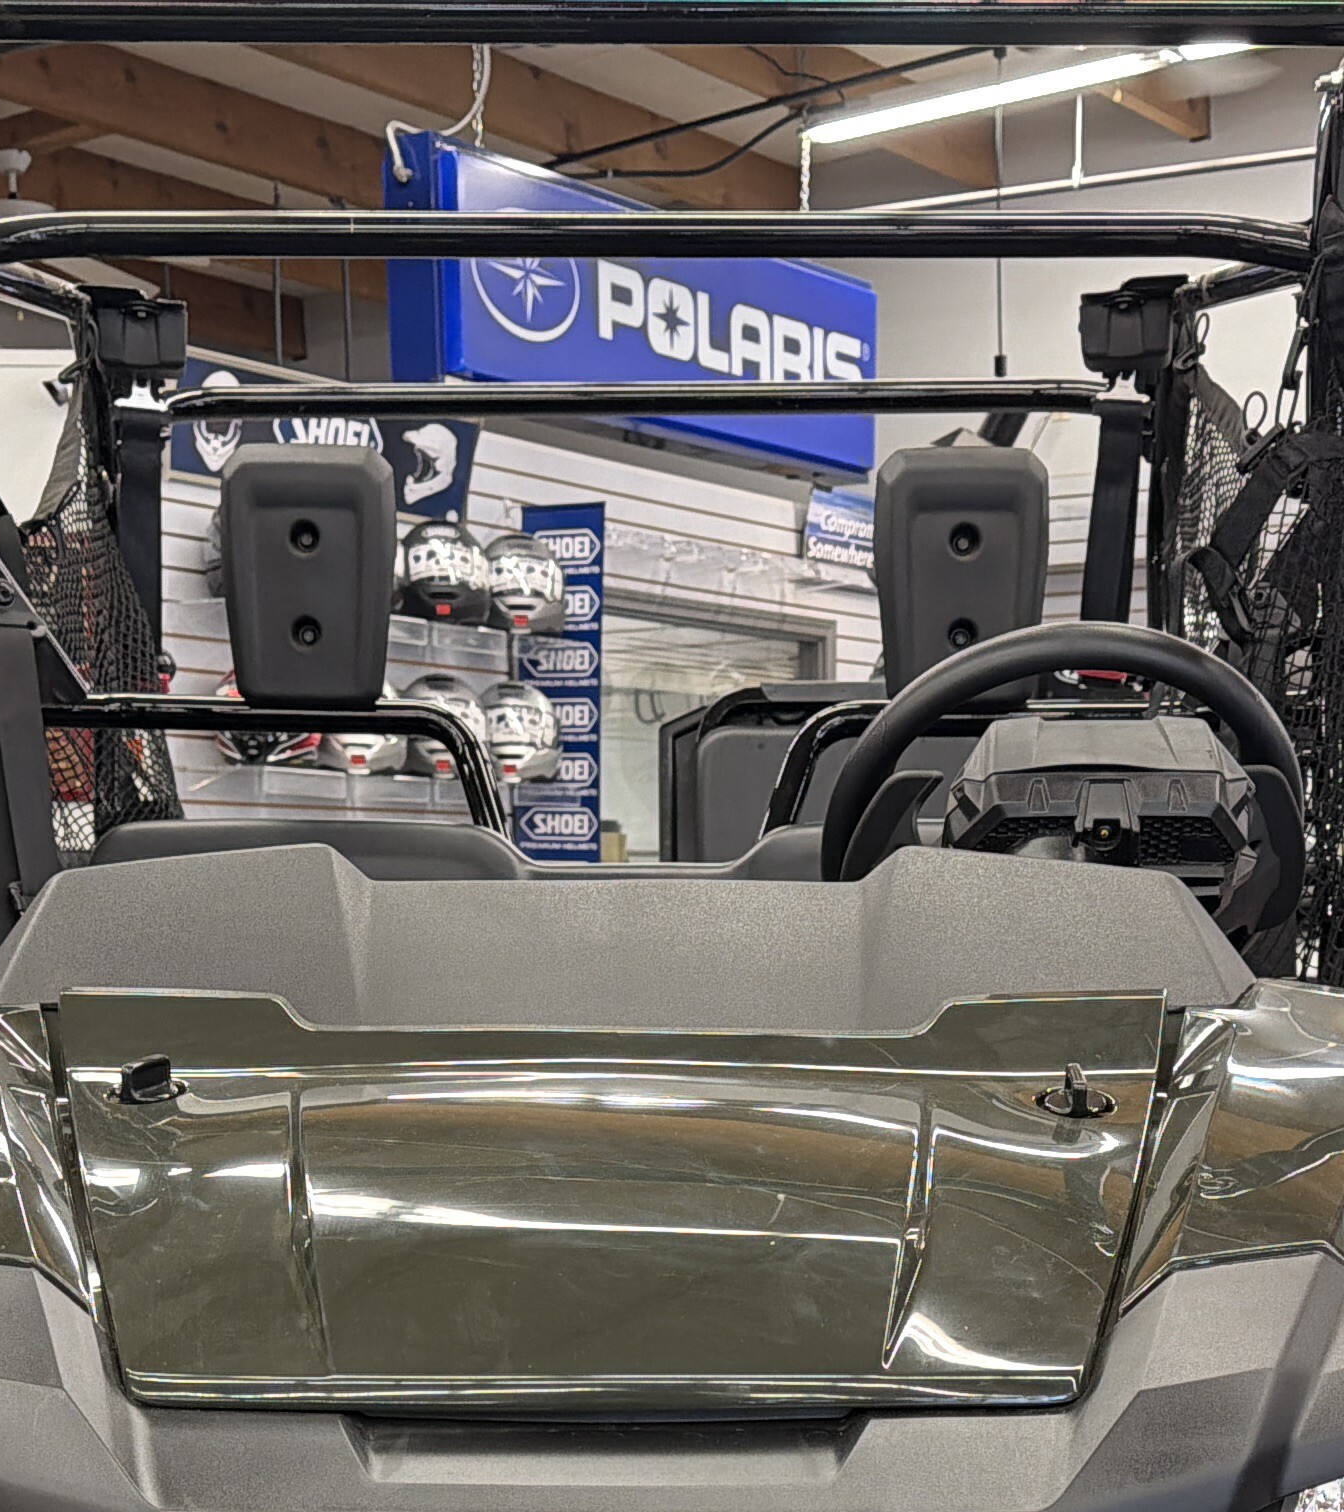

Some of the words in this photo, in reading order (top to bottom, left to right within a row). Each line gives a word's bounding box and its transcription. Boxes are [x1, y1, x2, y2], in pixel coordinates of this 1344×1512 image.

[597, 259, 863, 381] POLARIS
[819, 510, 875, 541] Comprom
[539, 536, 591, 559] HOEI
[807, 536, 875, 569] Somewhere
[536, 649, 590, 671] SHOEI
[532, 813, 590, 835] SHOEI
